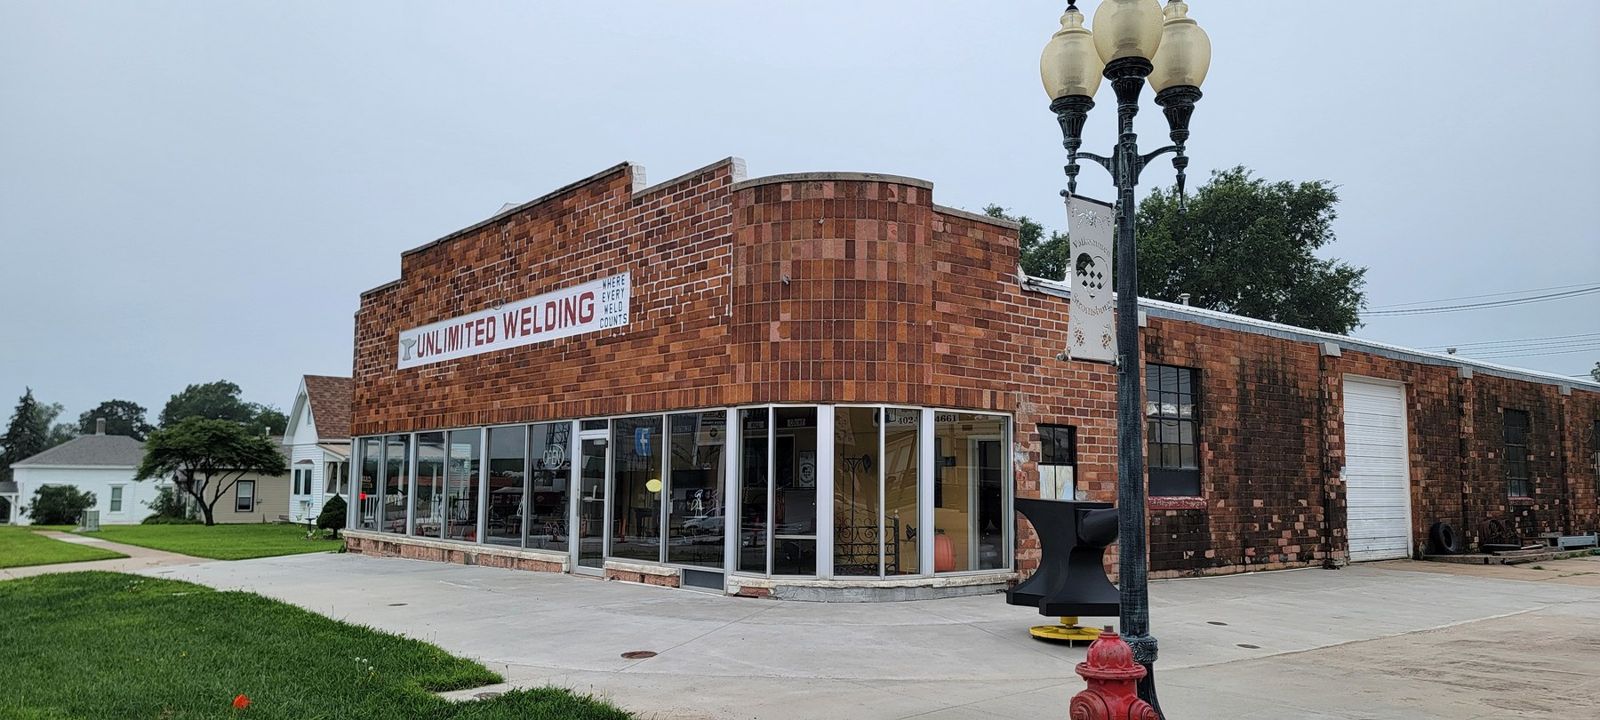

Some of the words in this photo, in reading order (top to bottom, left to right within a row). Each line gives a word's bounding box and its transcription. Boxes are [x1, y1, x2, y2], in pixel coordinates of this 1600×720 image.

[603, 274, 625, 289] WHERE
[602, 288, 624, 302] EVERY
[604, 301, 622, 314] WELD
[416, 316, 496, 358] UNLIMITED
[503, 291, 595, 340] WELDING
[600, 313, 627, 328] COUNTS
